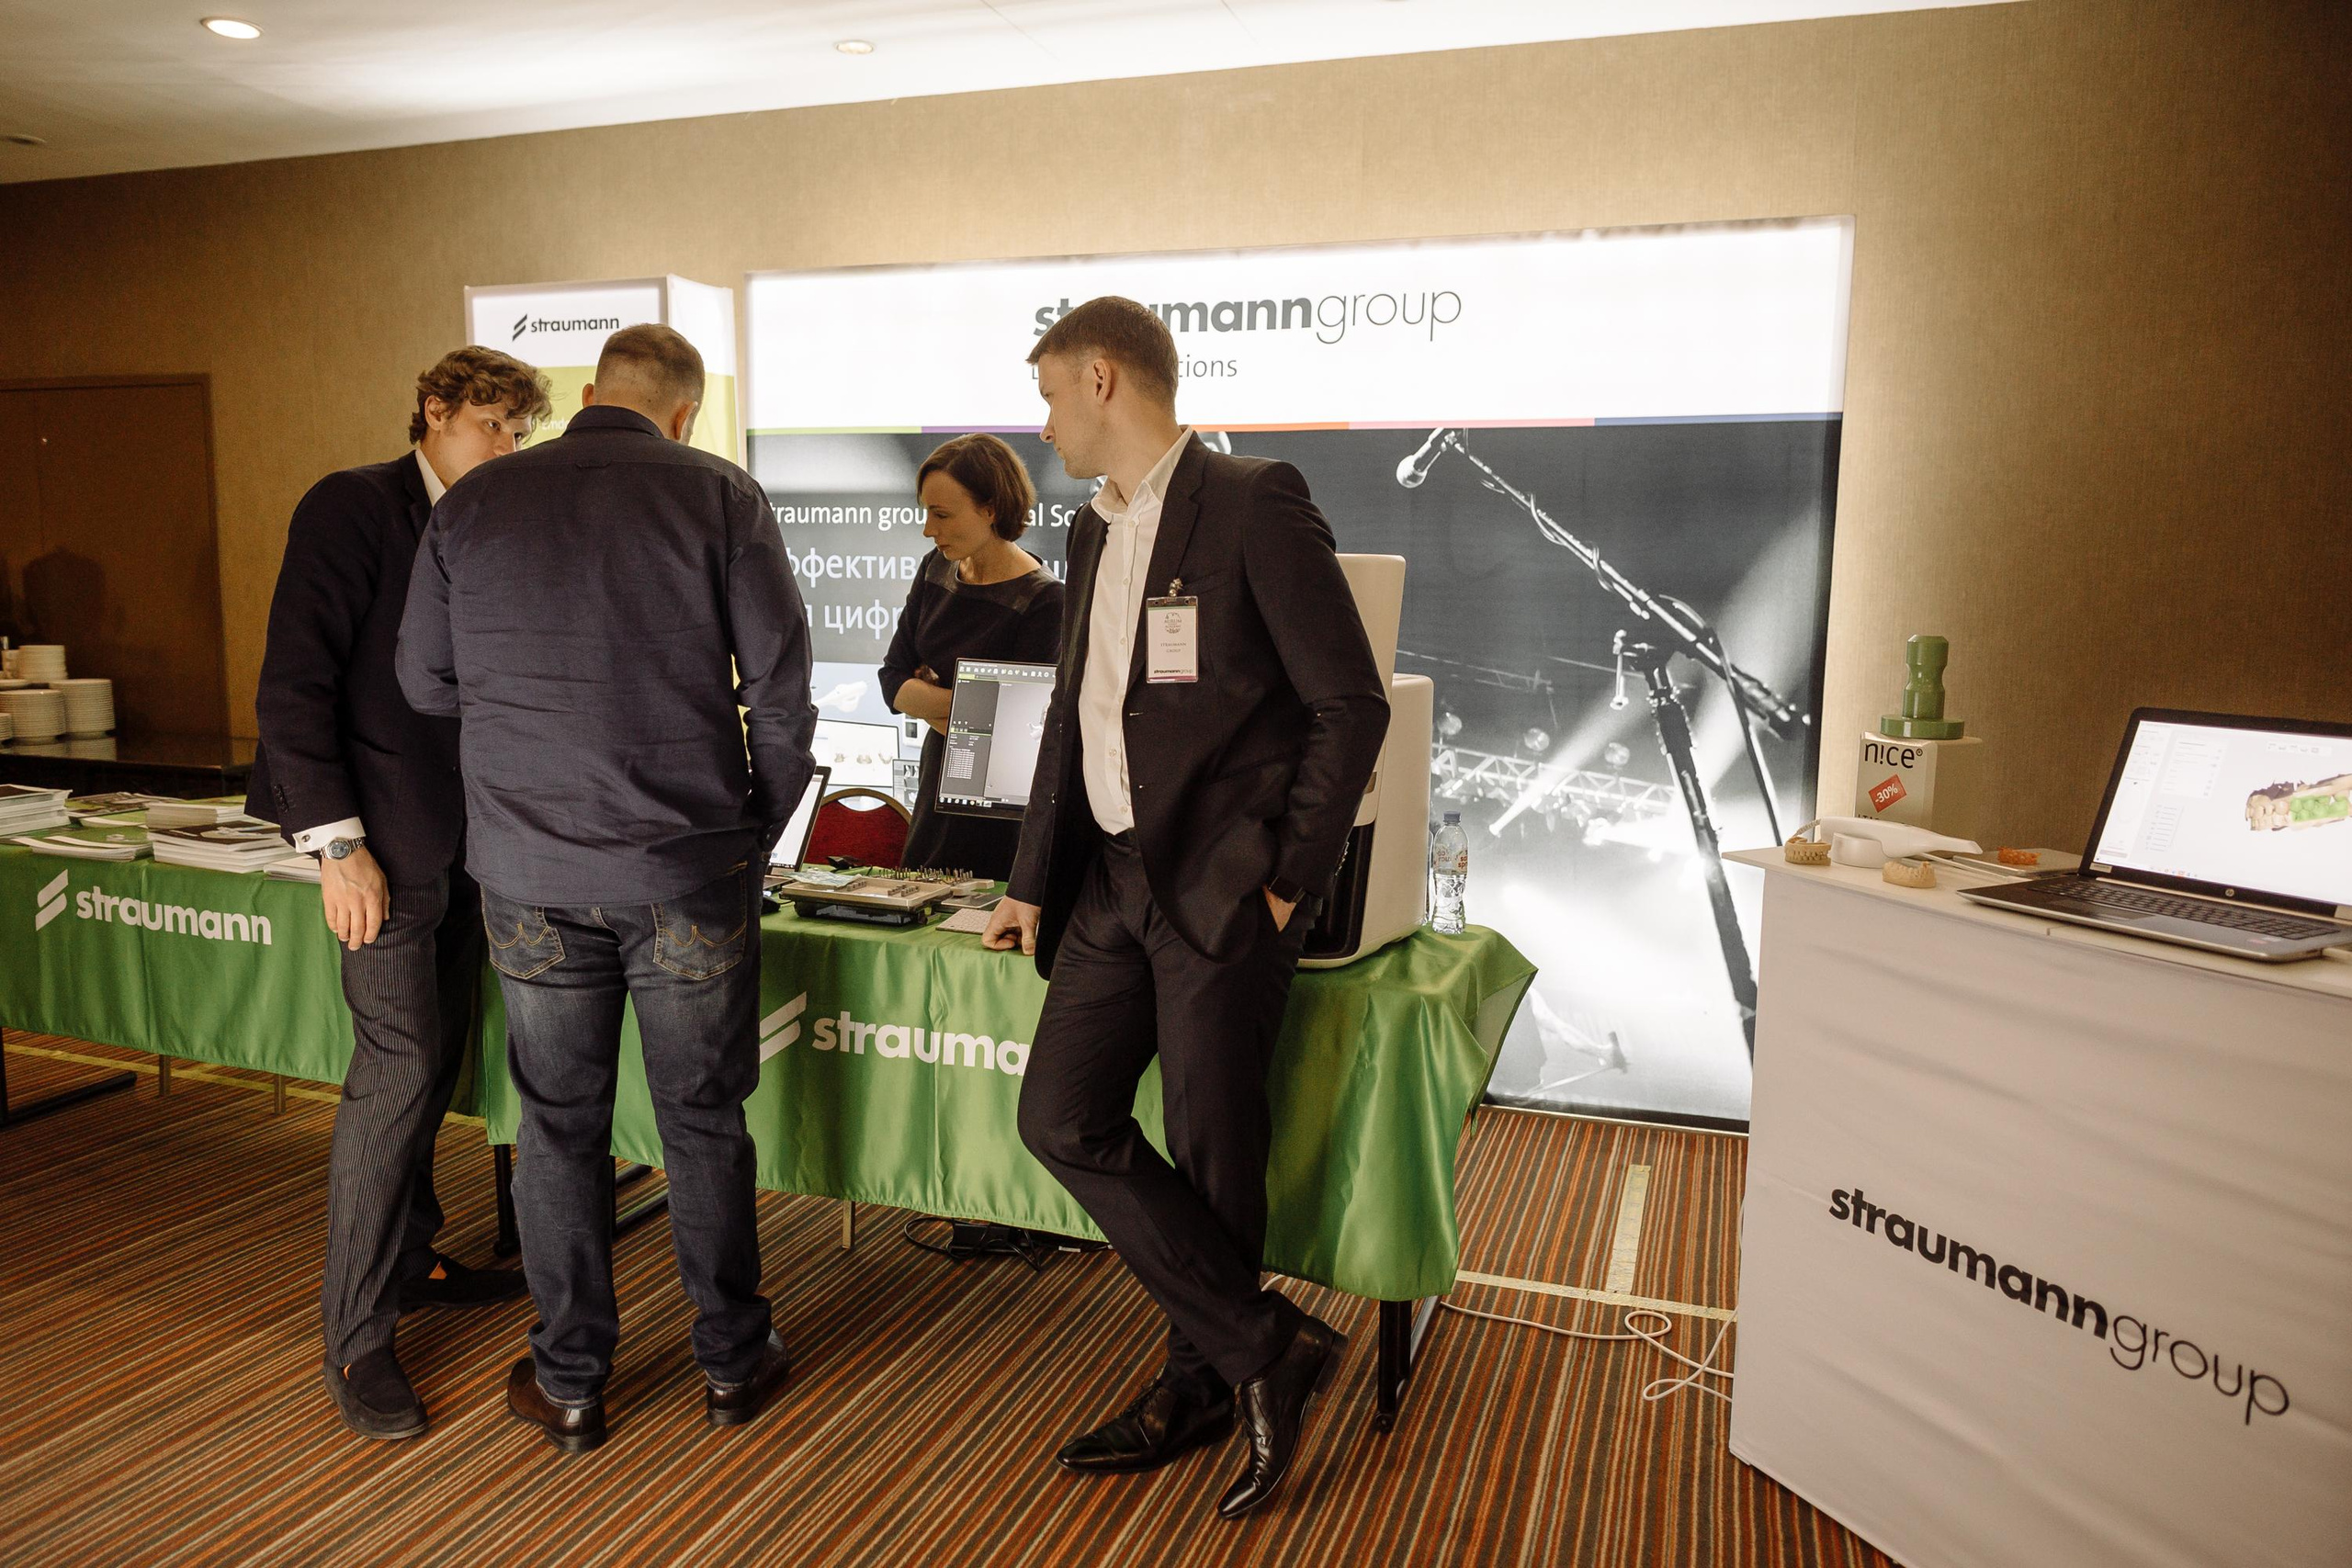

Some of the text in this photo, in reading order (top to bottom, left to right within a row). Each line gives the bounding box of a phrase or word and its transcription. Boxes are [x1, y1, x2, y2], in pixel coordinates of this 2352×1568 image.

[531, 317, 619, 333] straumann
[1033, 289, 1462, 344] stmanngroup
[770, 502, 928, 531] raumann grou
[1875, 783, 1899, 804] -30%
[76, 885, 272, 945] straumann
[812, 1010, 1033, 1077] strauma
[1828, 1188, 2290, 1426] straumanngroup
